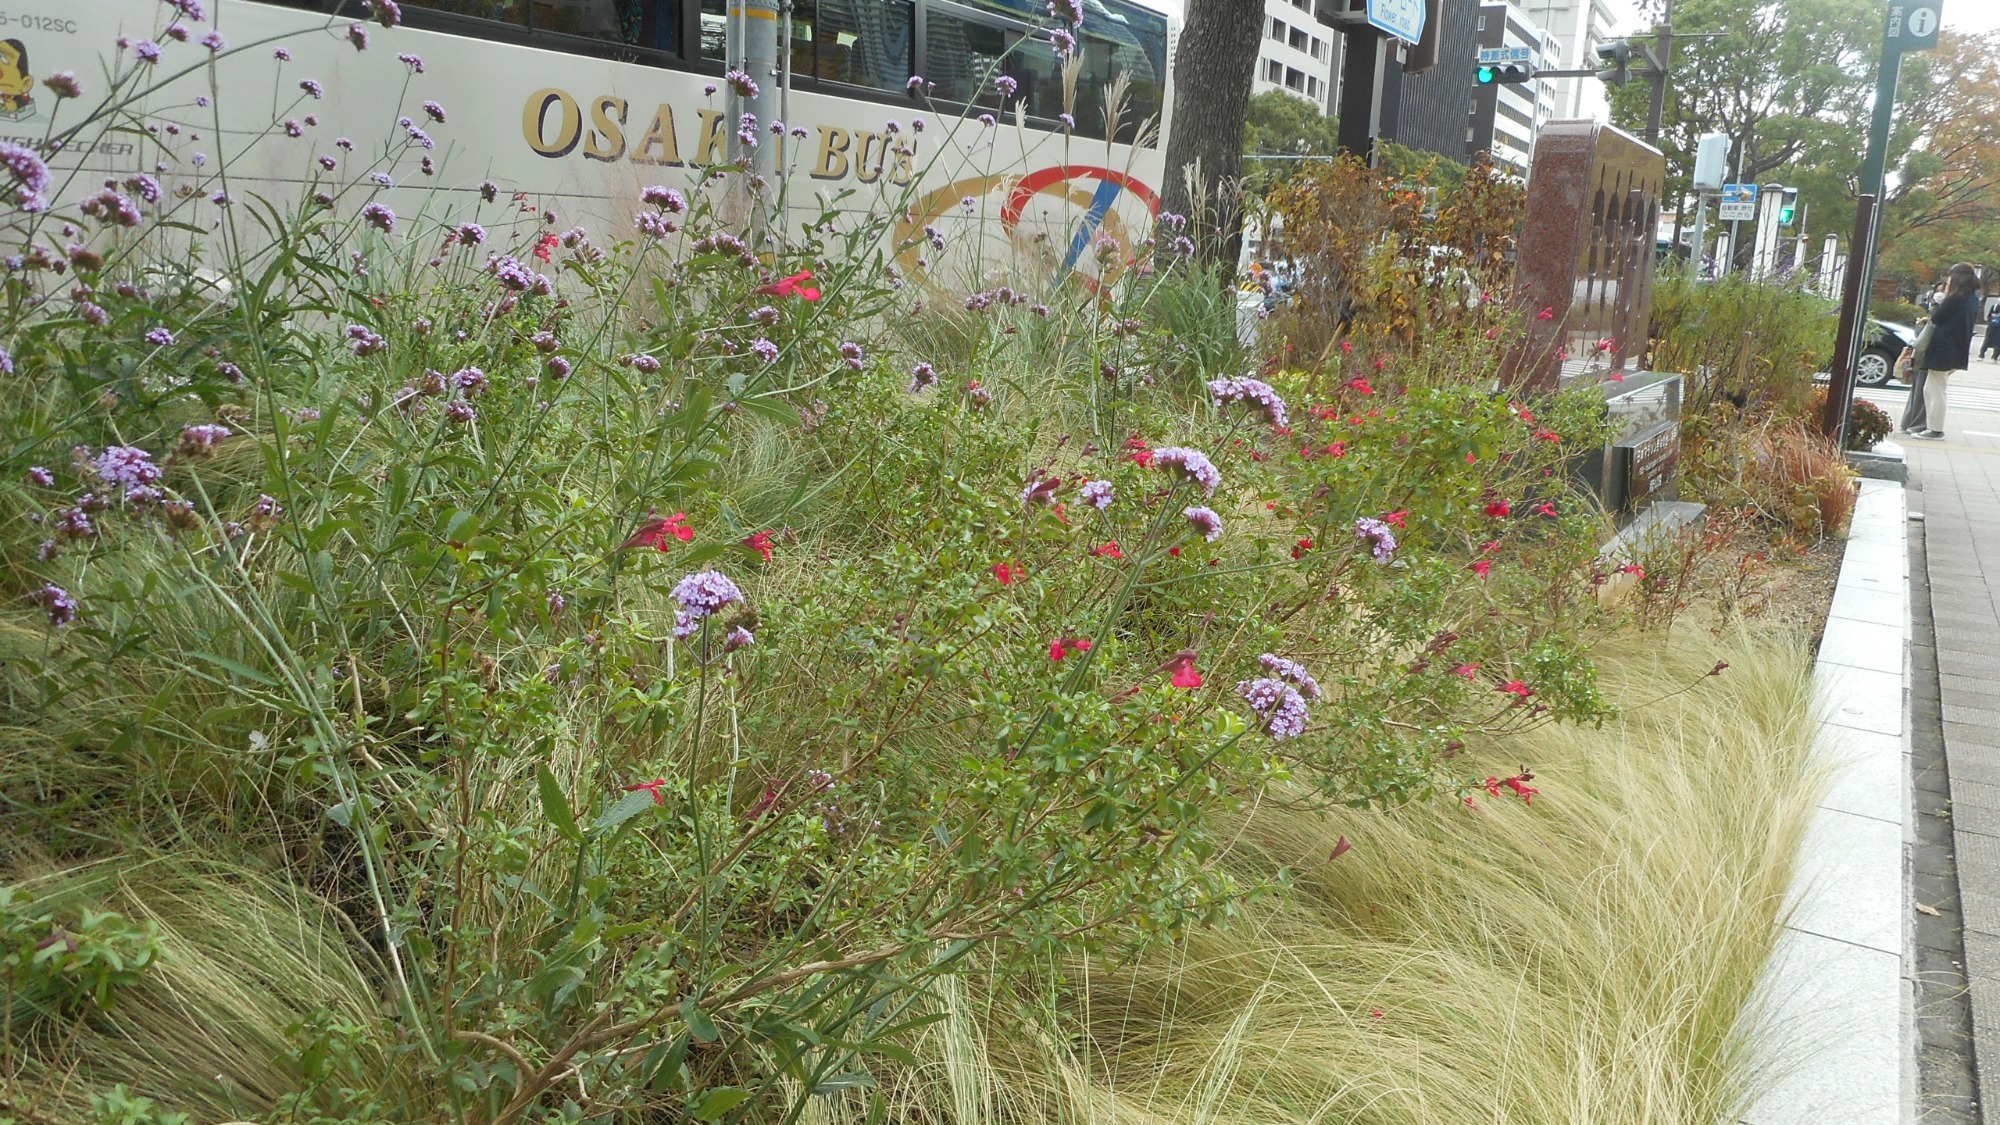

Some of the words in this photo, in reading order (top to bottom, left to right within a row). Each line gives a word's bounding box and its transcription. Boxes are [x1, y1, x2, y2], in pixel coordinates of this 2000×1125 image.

[1888, 6, 1903, 37] 案内図
[1480, 48, 1529, 61] 時差式信号
[522, 88, 783, 177] OSAK
[810, 124, 919, 188] BUS
